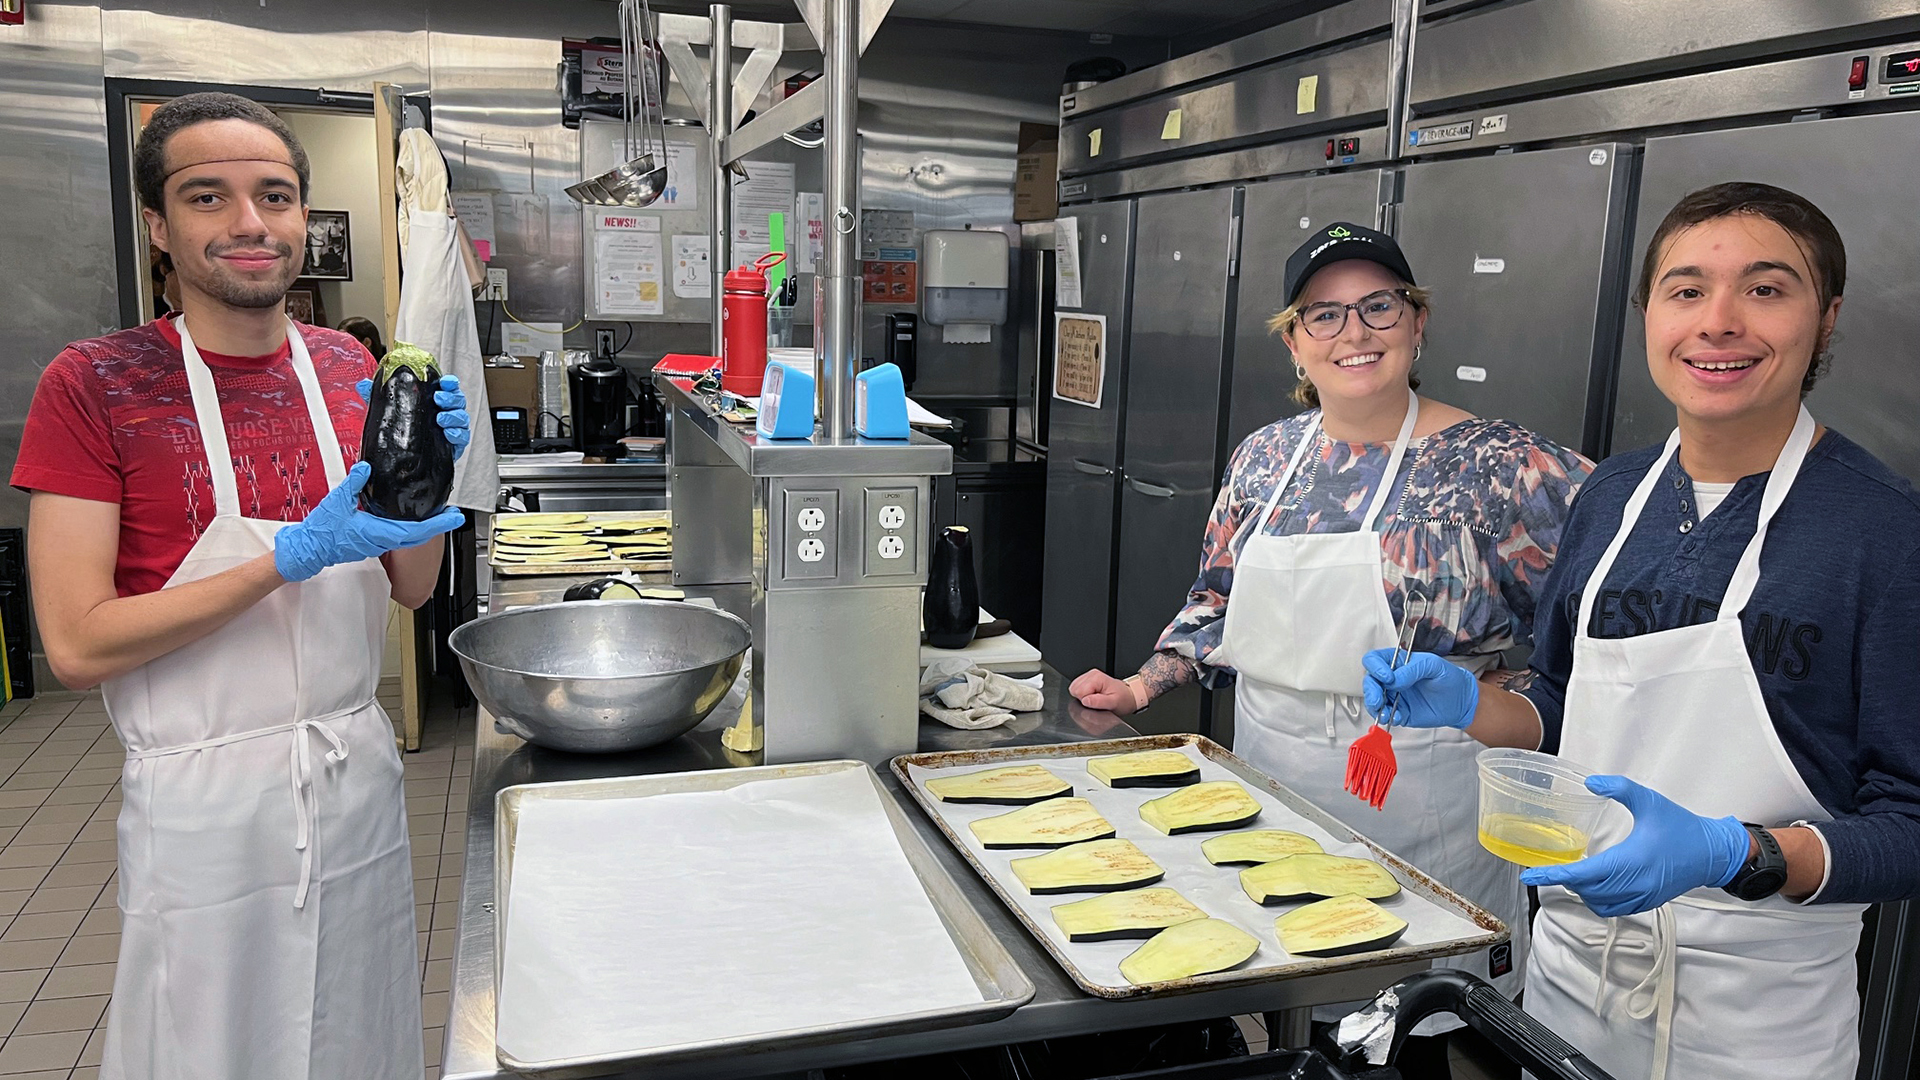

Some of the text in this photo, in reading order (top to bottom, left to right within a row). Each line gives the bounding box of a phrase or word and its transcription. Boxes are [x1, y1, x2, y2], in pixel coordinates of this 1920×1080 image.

[604, 59, 624, 67] Stern
[604, 217, 637, 229] NEWS!!
[174, 444, 192, 454] WE
[252, 436, 283, 448] FOCUS
